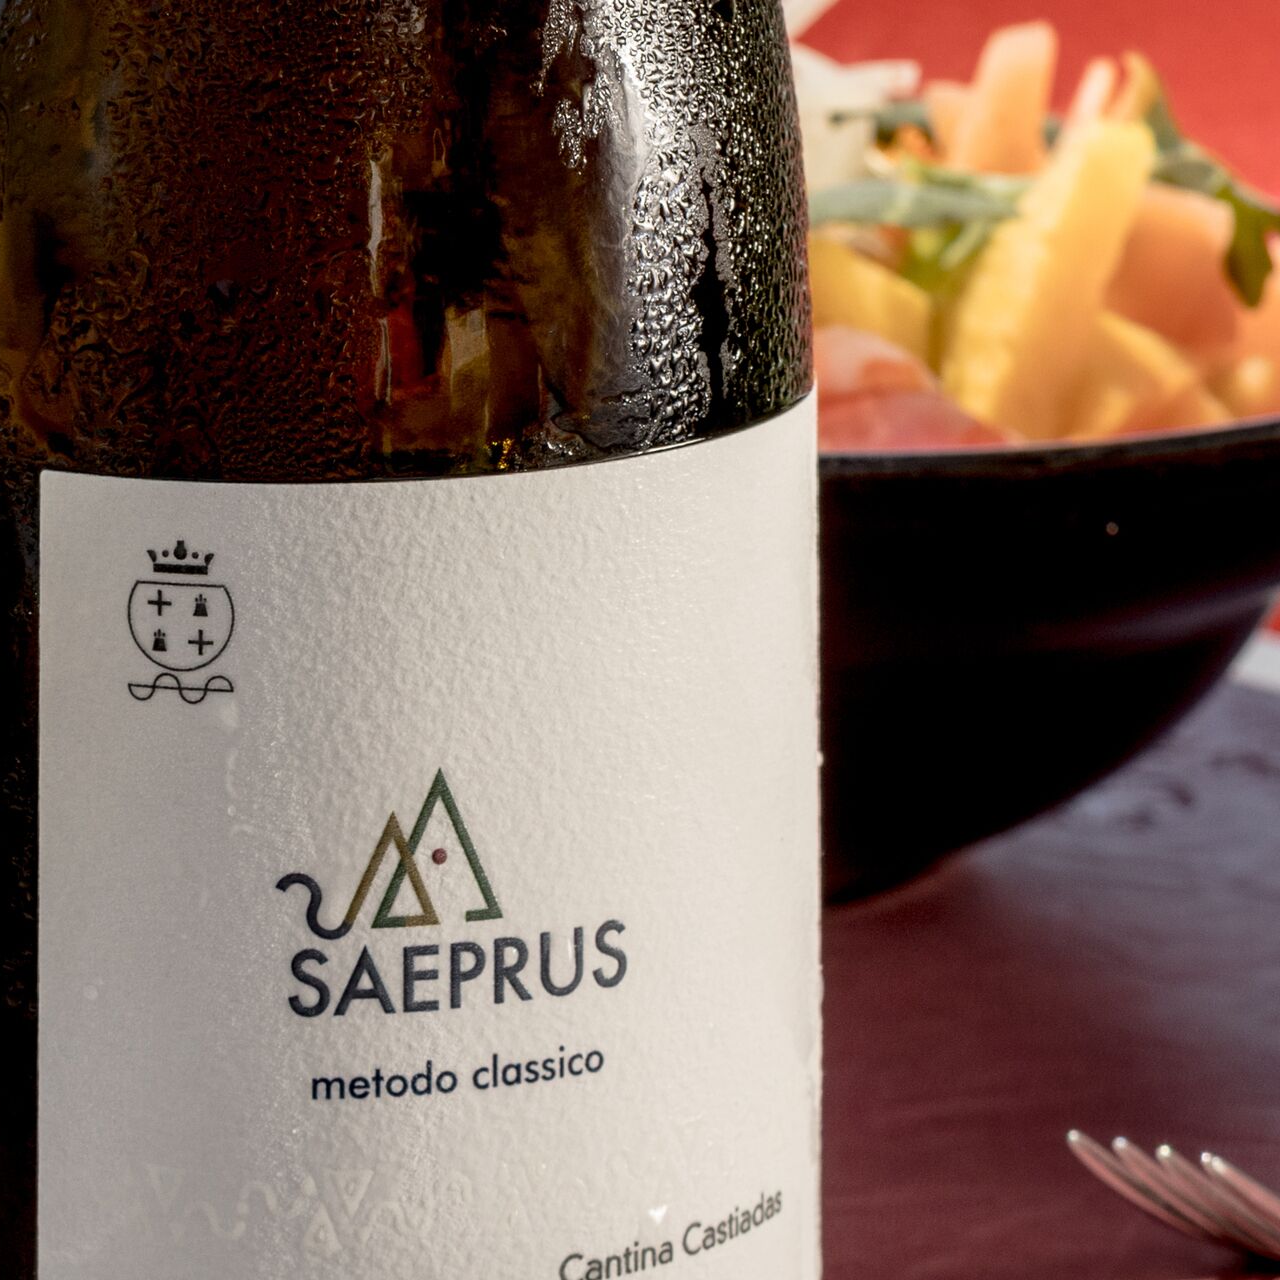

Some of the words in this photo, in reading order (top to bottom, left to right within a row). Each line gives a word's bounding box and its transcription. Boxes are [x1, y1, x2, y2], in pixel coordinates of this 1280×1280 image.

[287, 918, 629, 1019] SAEPRUS
[311, 1059, 459, 1101] metodo
[471, 1044, 605, 1091] classico
[680, 1190, 783, 1257] Castiadas
